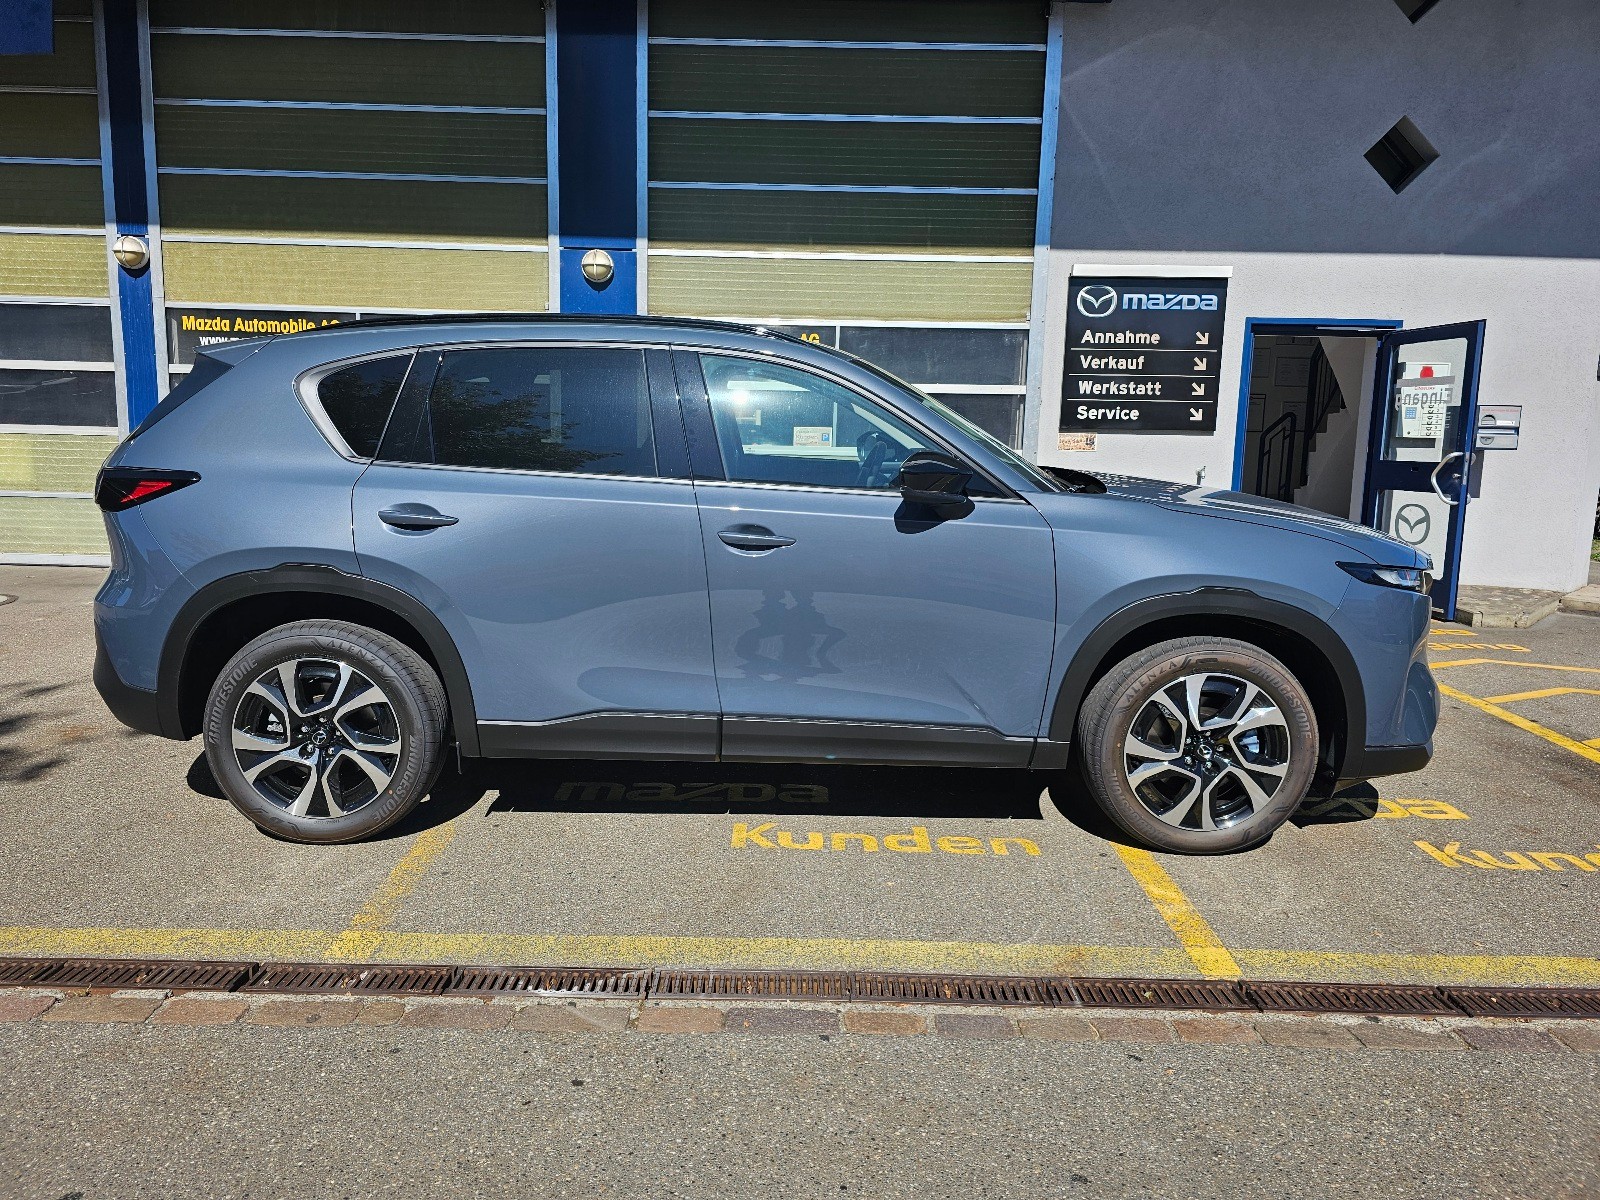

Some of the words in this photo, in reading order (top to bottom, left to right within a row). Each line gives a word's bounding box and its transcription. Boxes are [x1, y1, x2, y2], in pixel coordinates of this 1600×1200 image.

[1122, 293, 1218, 311] mazda
[182, 315, 230, 332] Mazda
[234, 317, 316, 334] Automobile
[1081, 329, 1161, 345] Annahme
[1080, 355, 1145, 370] Verkauf
[1078, 380, 1162, 396] Werkstatt
[1076, 405, 1140, 421] Service
[325, 639, 388, 673] ALENZA
[1125, 661, 1178, 704] ALENZA
[208, 658, 258, 745] BRIDGESTONE
[1249, 661, 1312, 739] BRIDGESTONE
[371, 733, 422, 824] BRIDGESTONE
[731, 821, 1042, 857] Kunden
[1412, 840, 1600, 873] Kun
